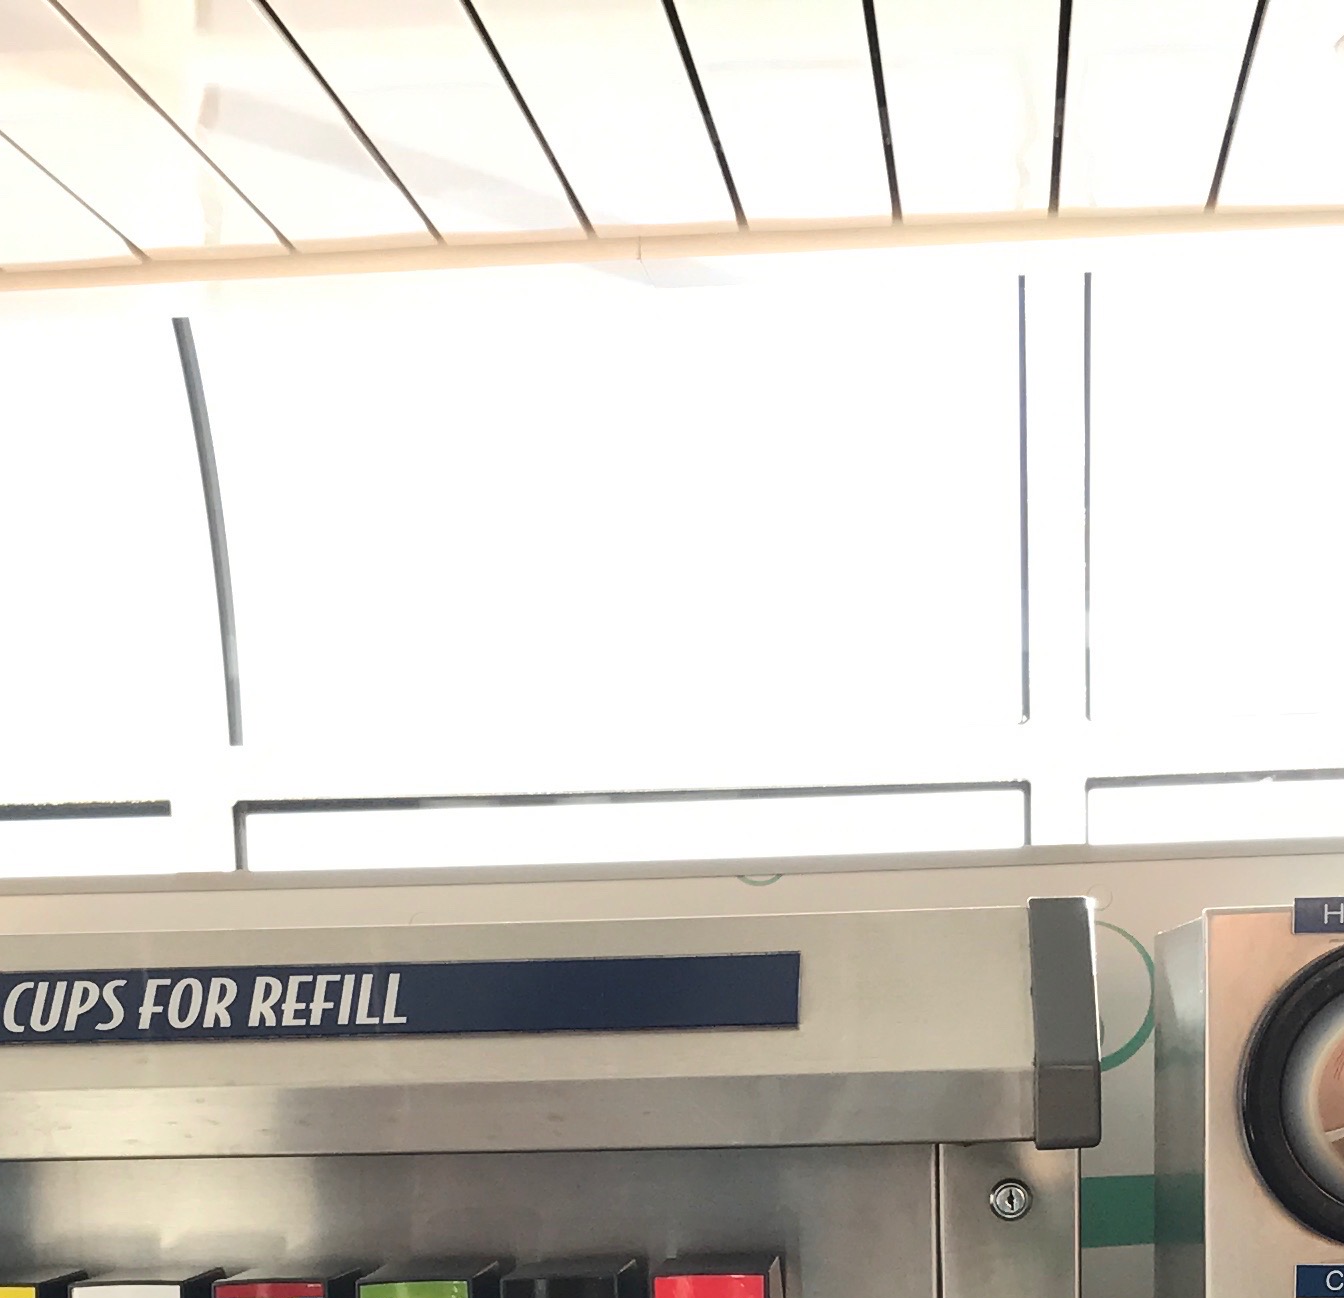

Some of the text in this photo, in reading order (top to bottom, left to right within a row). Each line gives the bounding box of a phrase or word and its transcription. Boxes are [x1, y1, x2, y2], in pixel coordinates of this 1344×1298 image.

[2, 978, 127, 1032] CUPS
[137, 976, 238, 1030] FOR
[247, 972, 408, 1027] REFILL
